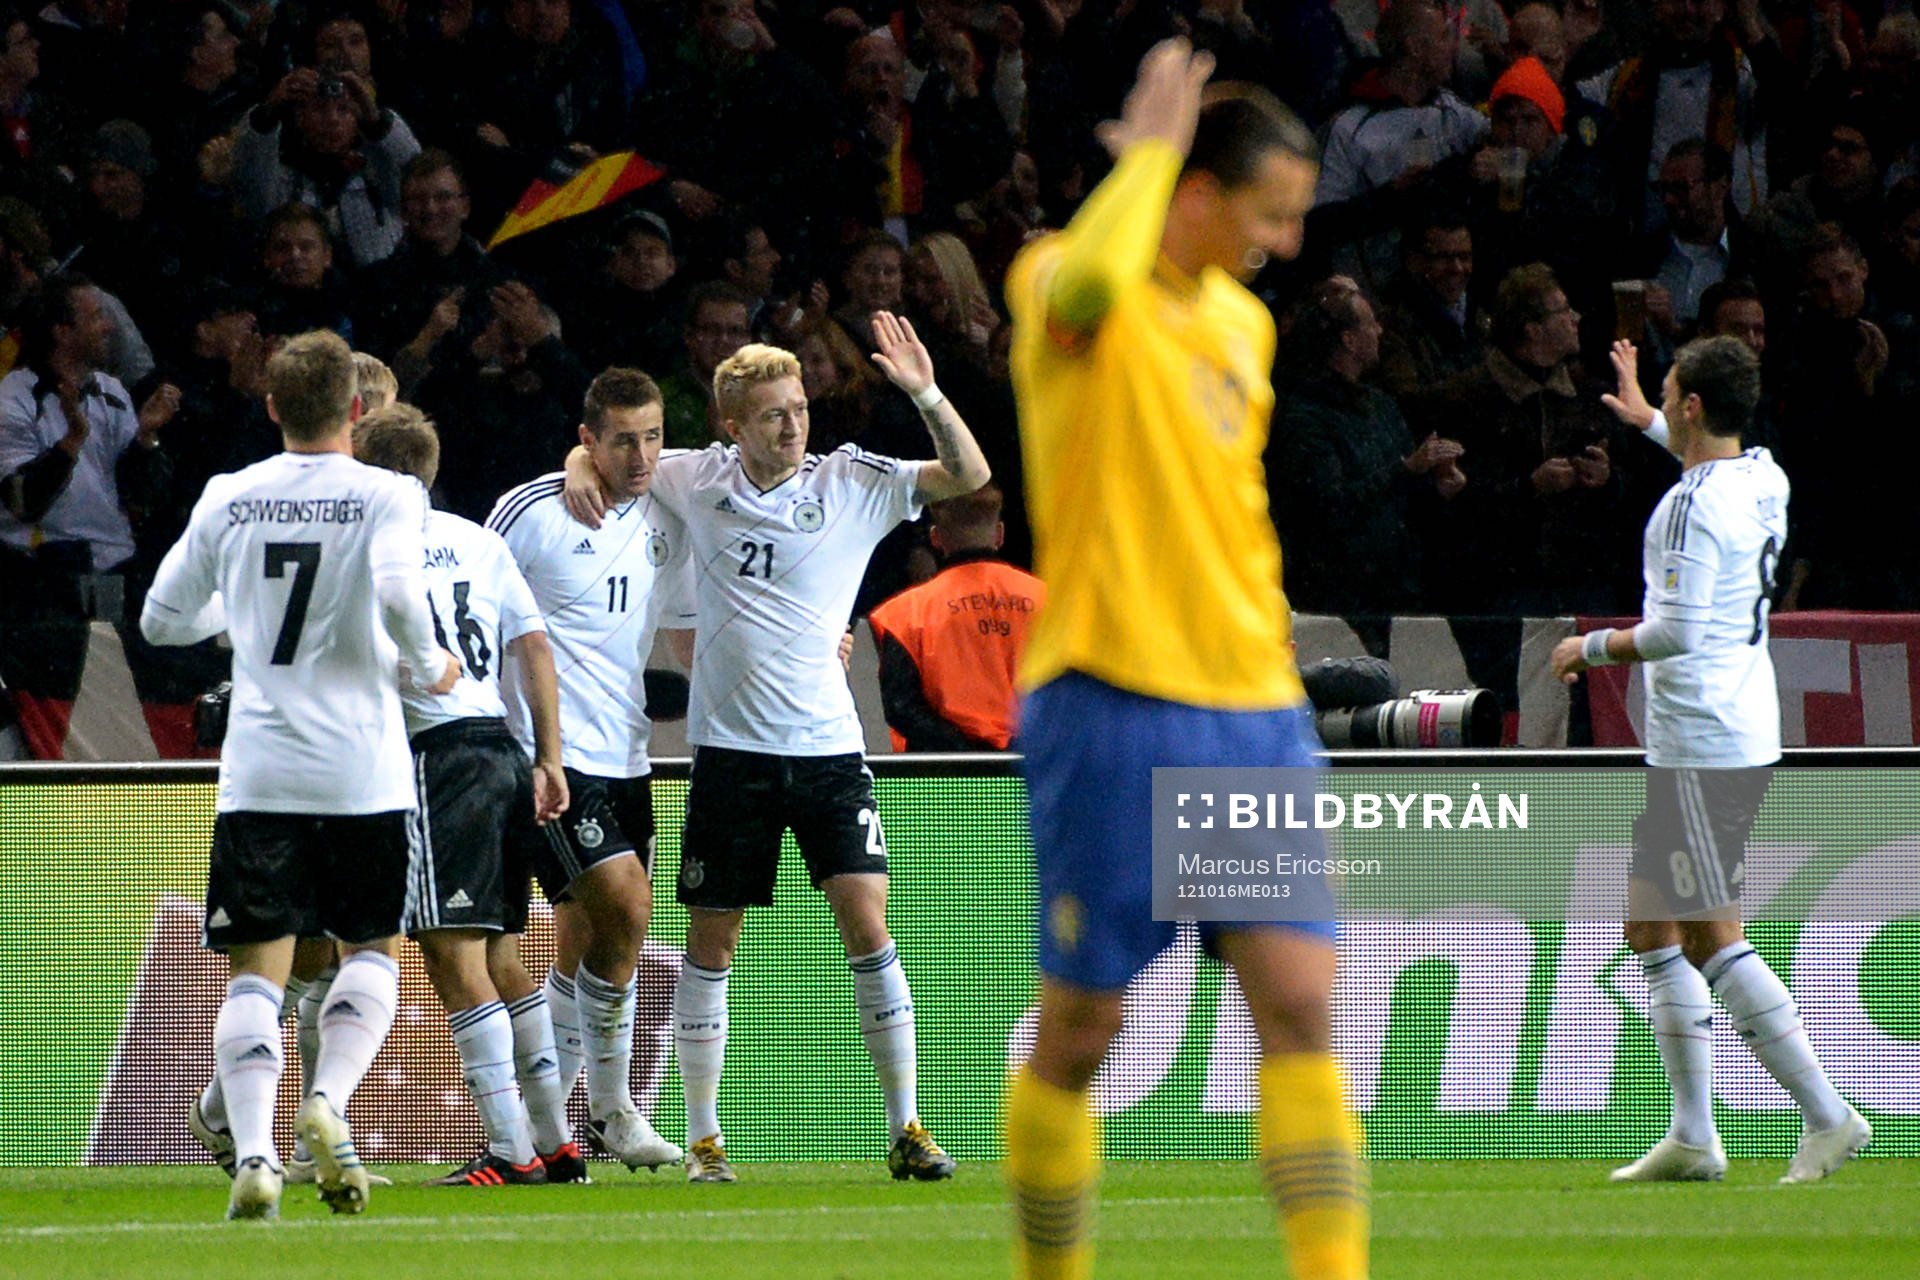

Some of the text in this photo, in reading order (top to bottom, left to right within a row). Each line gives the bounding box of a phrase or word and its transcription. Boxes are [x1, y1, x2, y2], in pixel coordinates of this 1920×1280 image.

[229, 499, 364, 526] SCHWEINSTEIGER
[422, 546, 460, 569] AHM
[738, 541, 775, 579] 21
[264, 542, 321, 665] 7
[607, 575, 628, 613] 11
[947, 592, 1035, 615] STEWARD
[1669, 850, 1697, 898] 8
